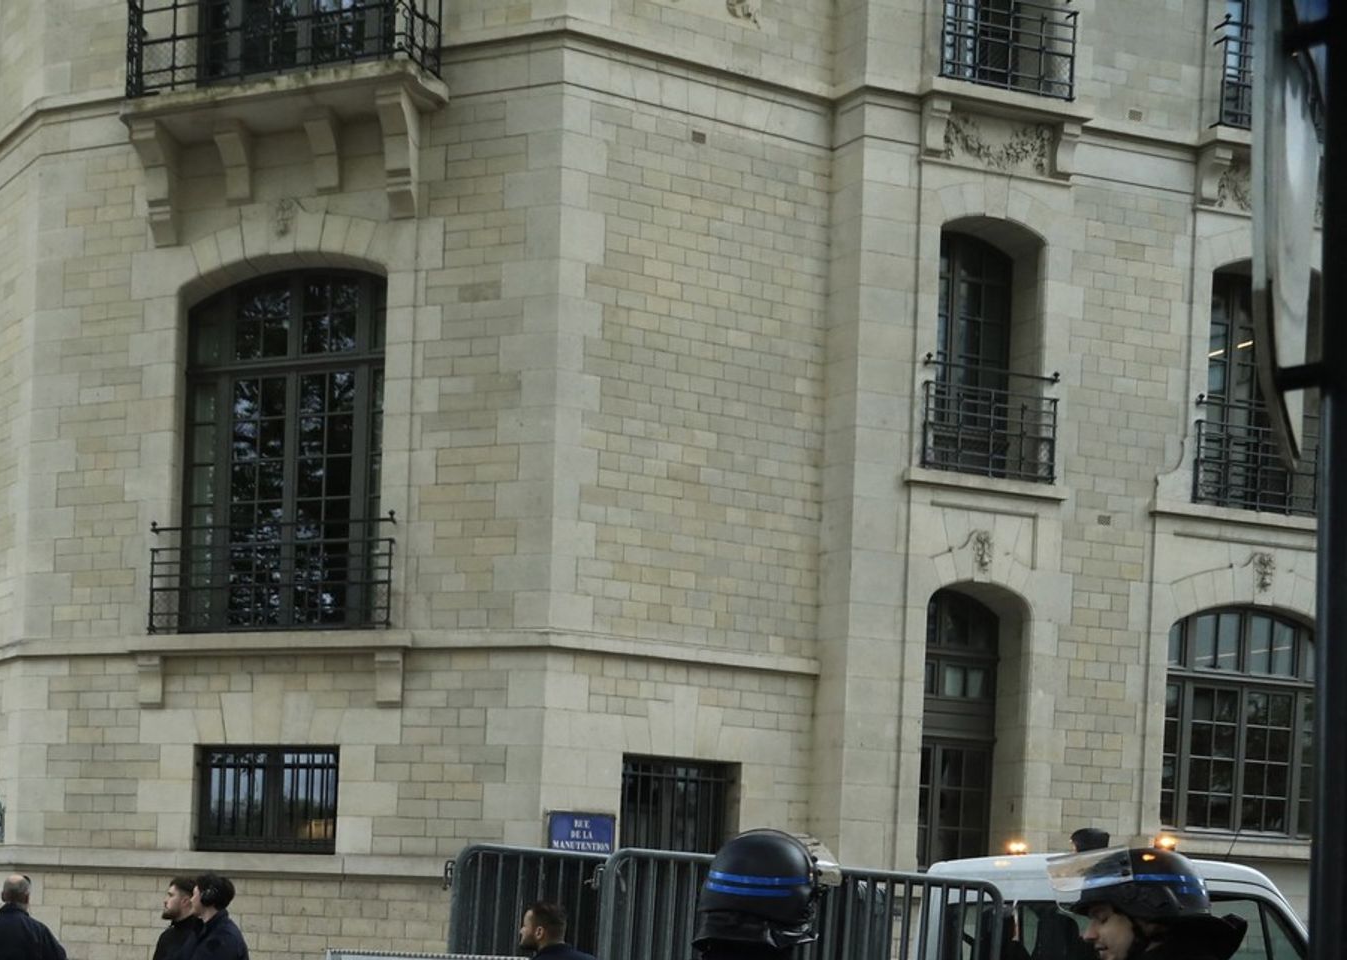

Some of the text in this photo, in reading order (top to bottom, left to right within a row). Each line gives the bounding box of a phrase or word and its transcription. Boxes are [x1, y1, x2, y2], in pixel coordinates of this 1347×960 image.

[574, 819, 590, 829] RUE
[570, 830, 593, 840] DE LA
[553, 839, 610, 851] MANUTENTION
